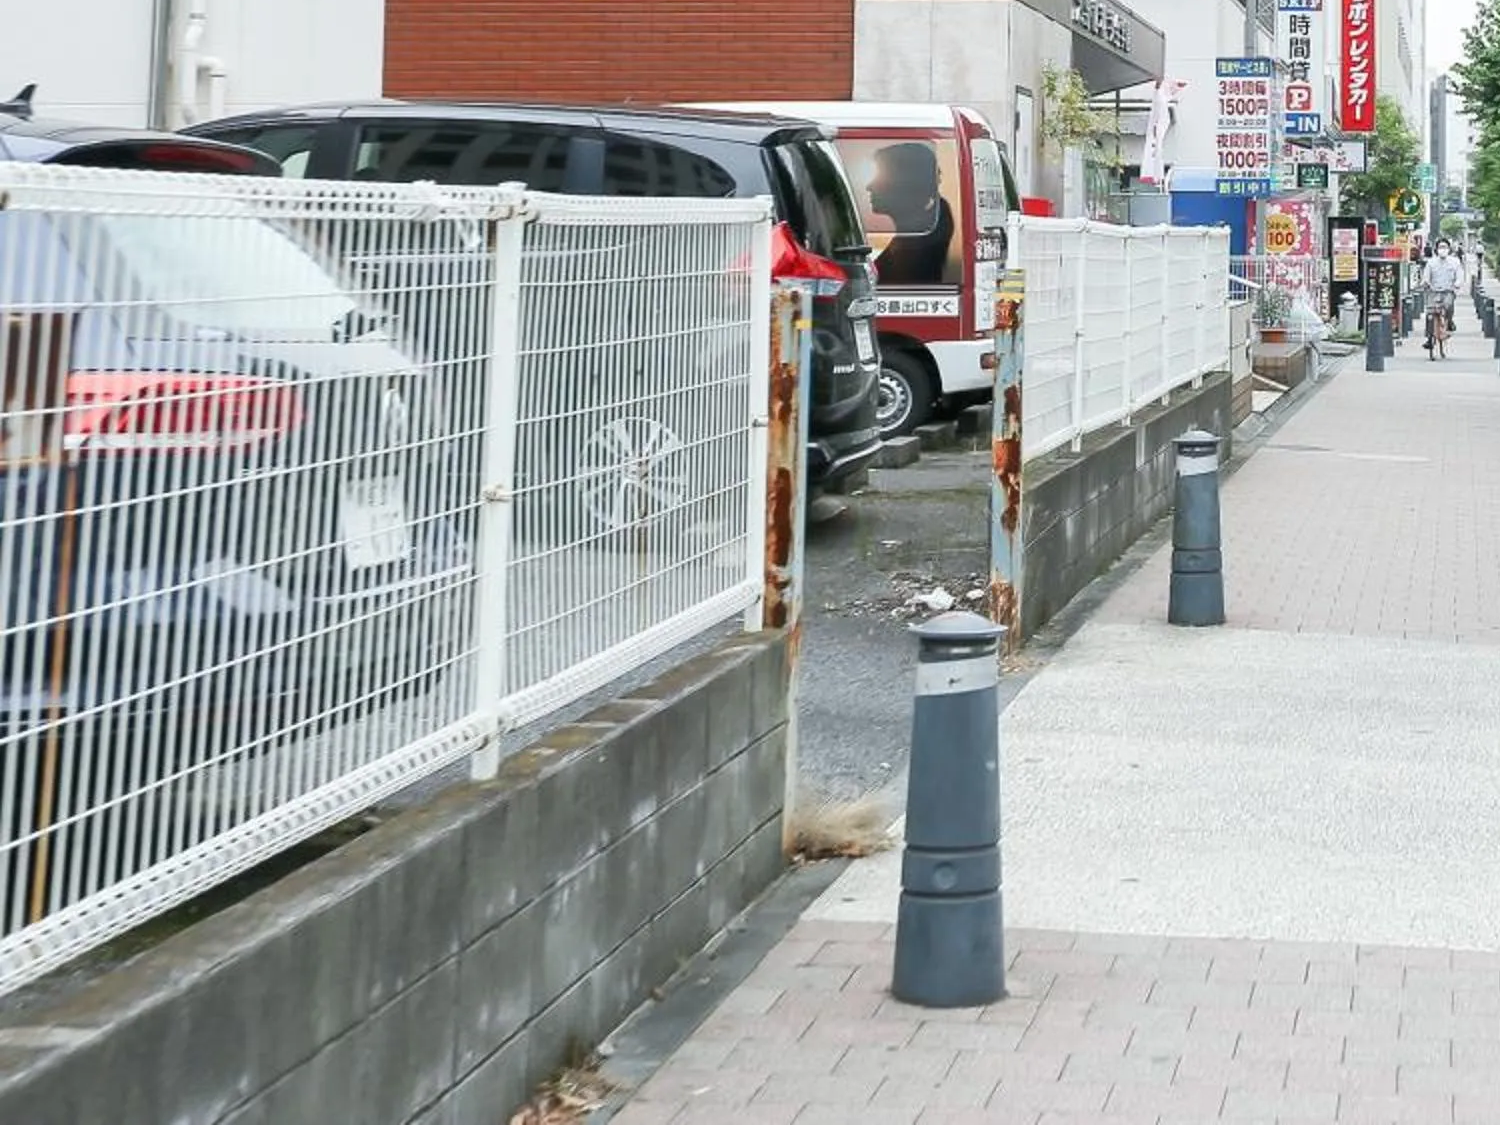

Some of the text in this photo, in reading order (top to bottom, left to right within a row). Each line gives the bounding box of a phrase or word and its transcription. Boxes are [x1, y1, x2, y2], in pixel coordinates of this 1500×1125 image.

[1218, 98, 1268, 116] 1500円
[1289, 88, 1309, 109] P
[1298, 117, 1319, 132] IN
[1217, 151, 1268, 168] 1000円
